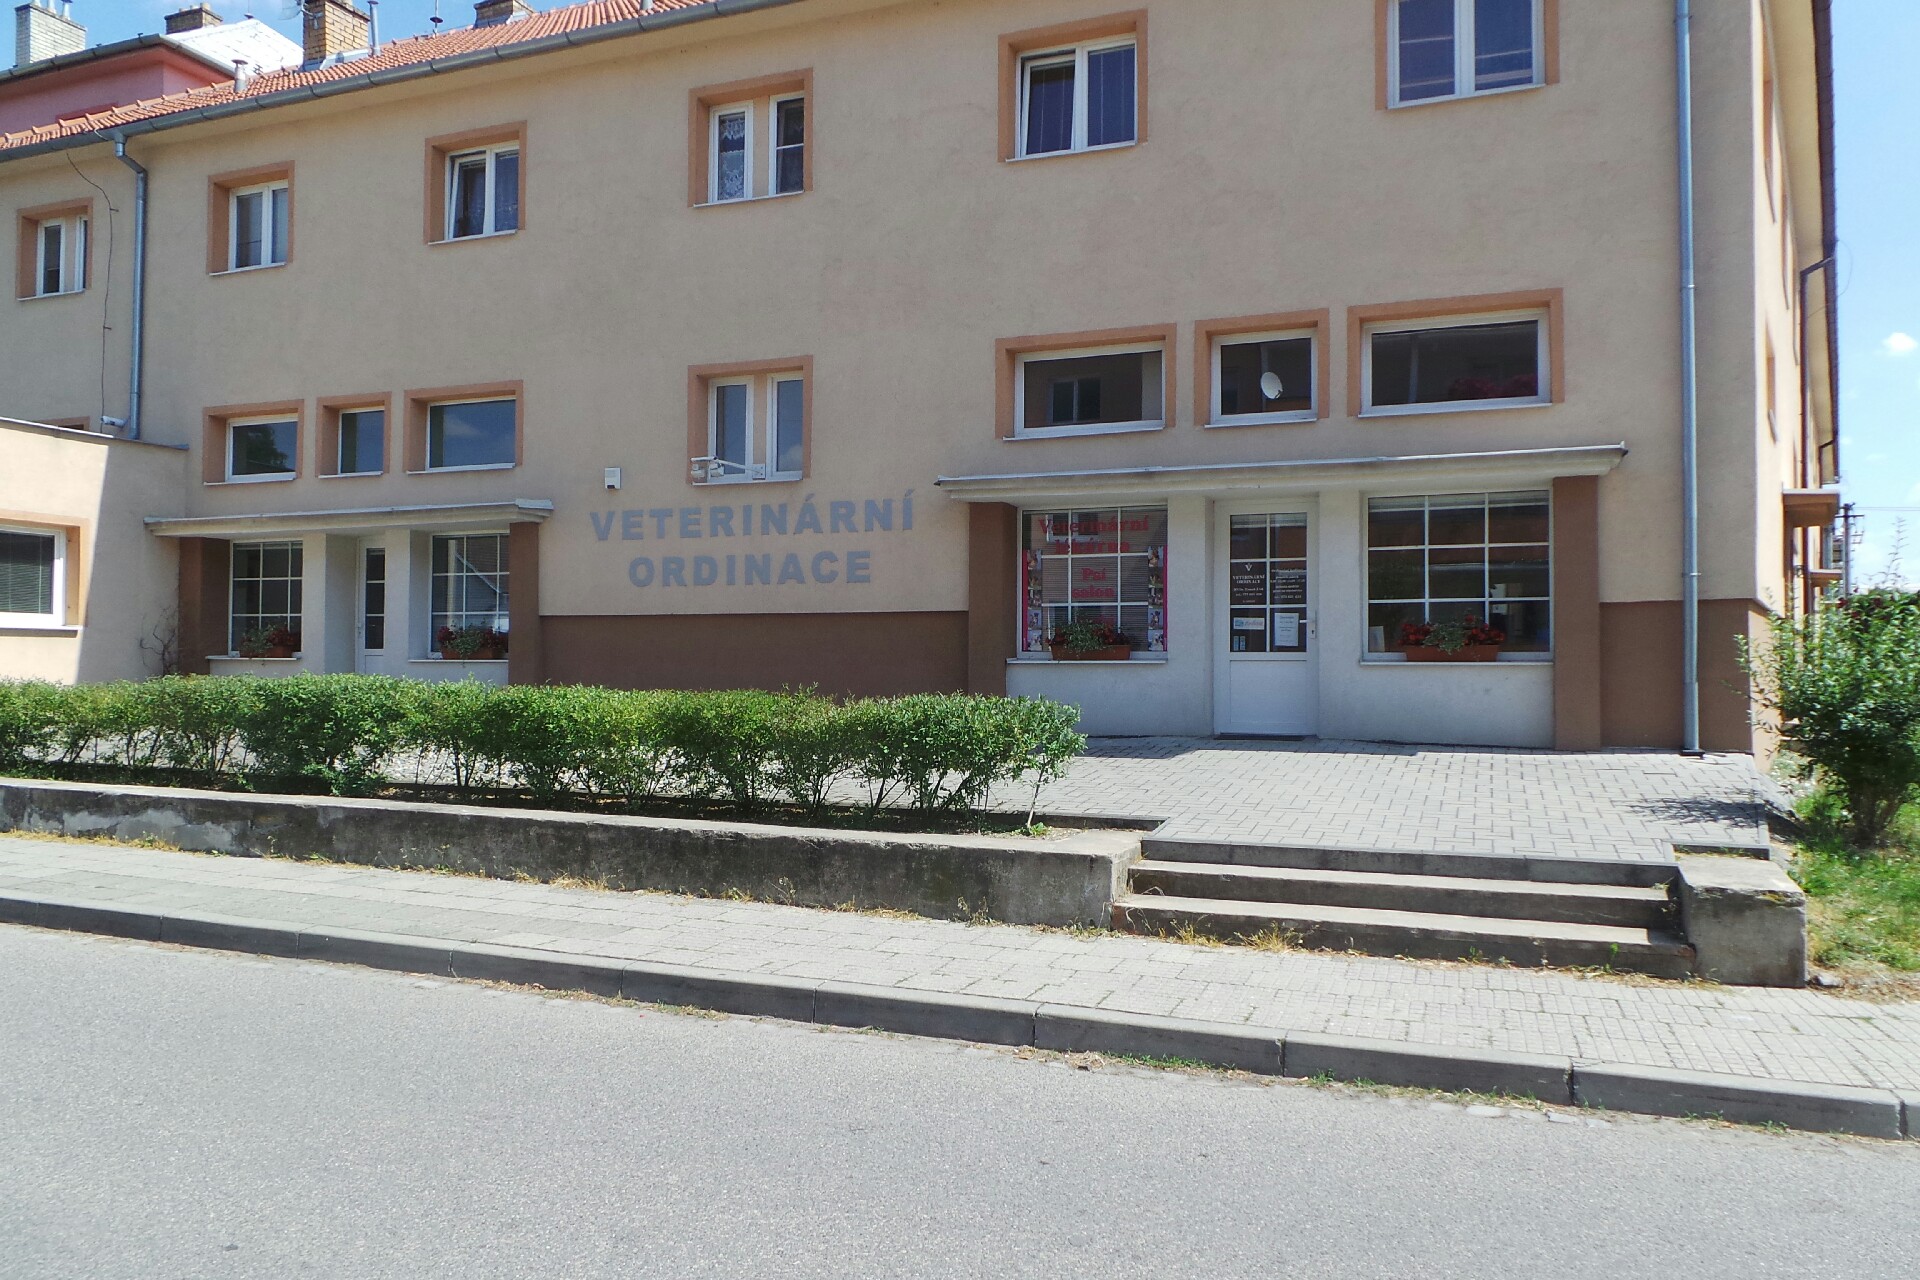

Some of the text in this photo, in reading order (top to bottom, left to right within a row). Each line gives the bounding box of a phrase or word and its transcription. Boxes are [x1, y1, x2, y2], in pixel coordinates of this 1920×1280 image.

[590, 489, 914, 541] VETERINÁRNÍ
[1038, 515, 1149, 534] Veterinární
[628, 551, 871, 587] ORDINACE
